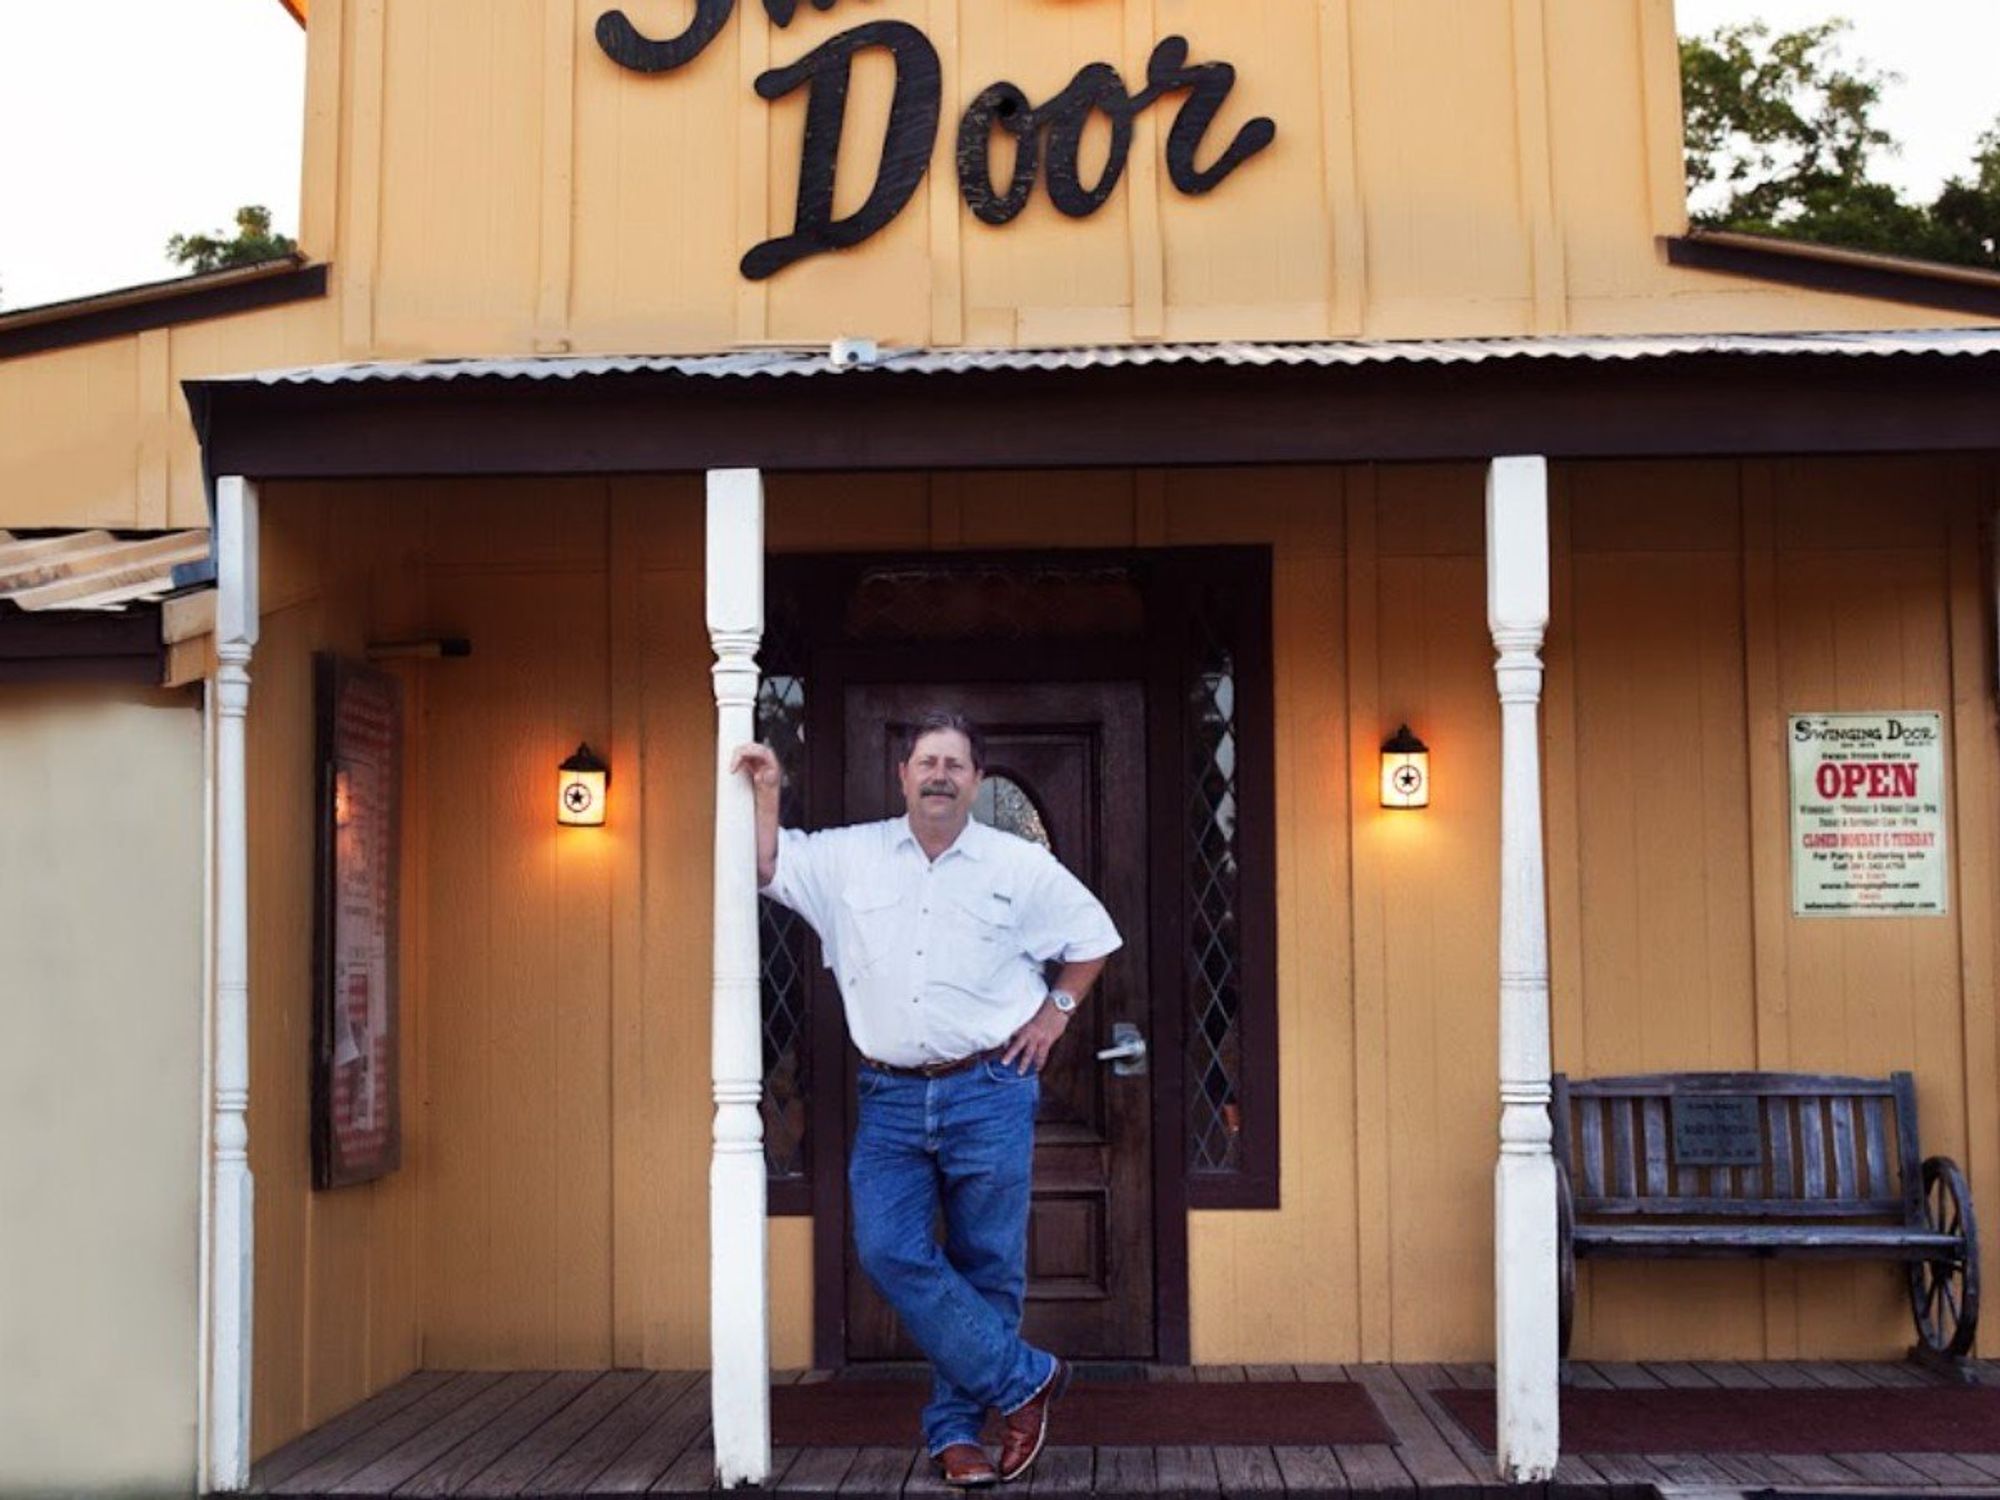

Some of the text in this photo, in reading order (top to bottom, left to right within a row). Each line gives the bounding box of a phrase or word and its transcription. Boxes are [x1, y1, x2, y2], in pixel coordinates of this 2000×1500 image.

[740, 20, 1276, 280] Door
[1816, 762, 1919, 799] OPEN
[1803, 833, 1838, 848] CLOSED
[1840, 833, 1880, 848] MONDAY
[1892, 832, 1935, 847] TUESDAY
